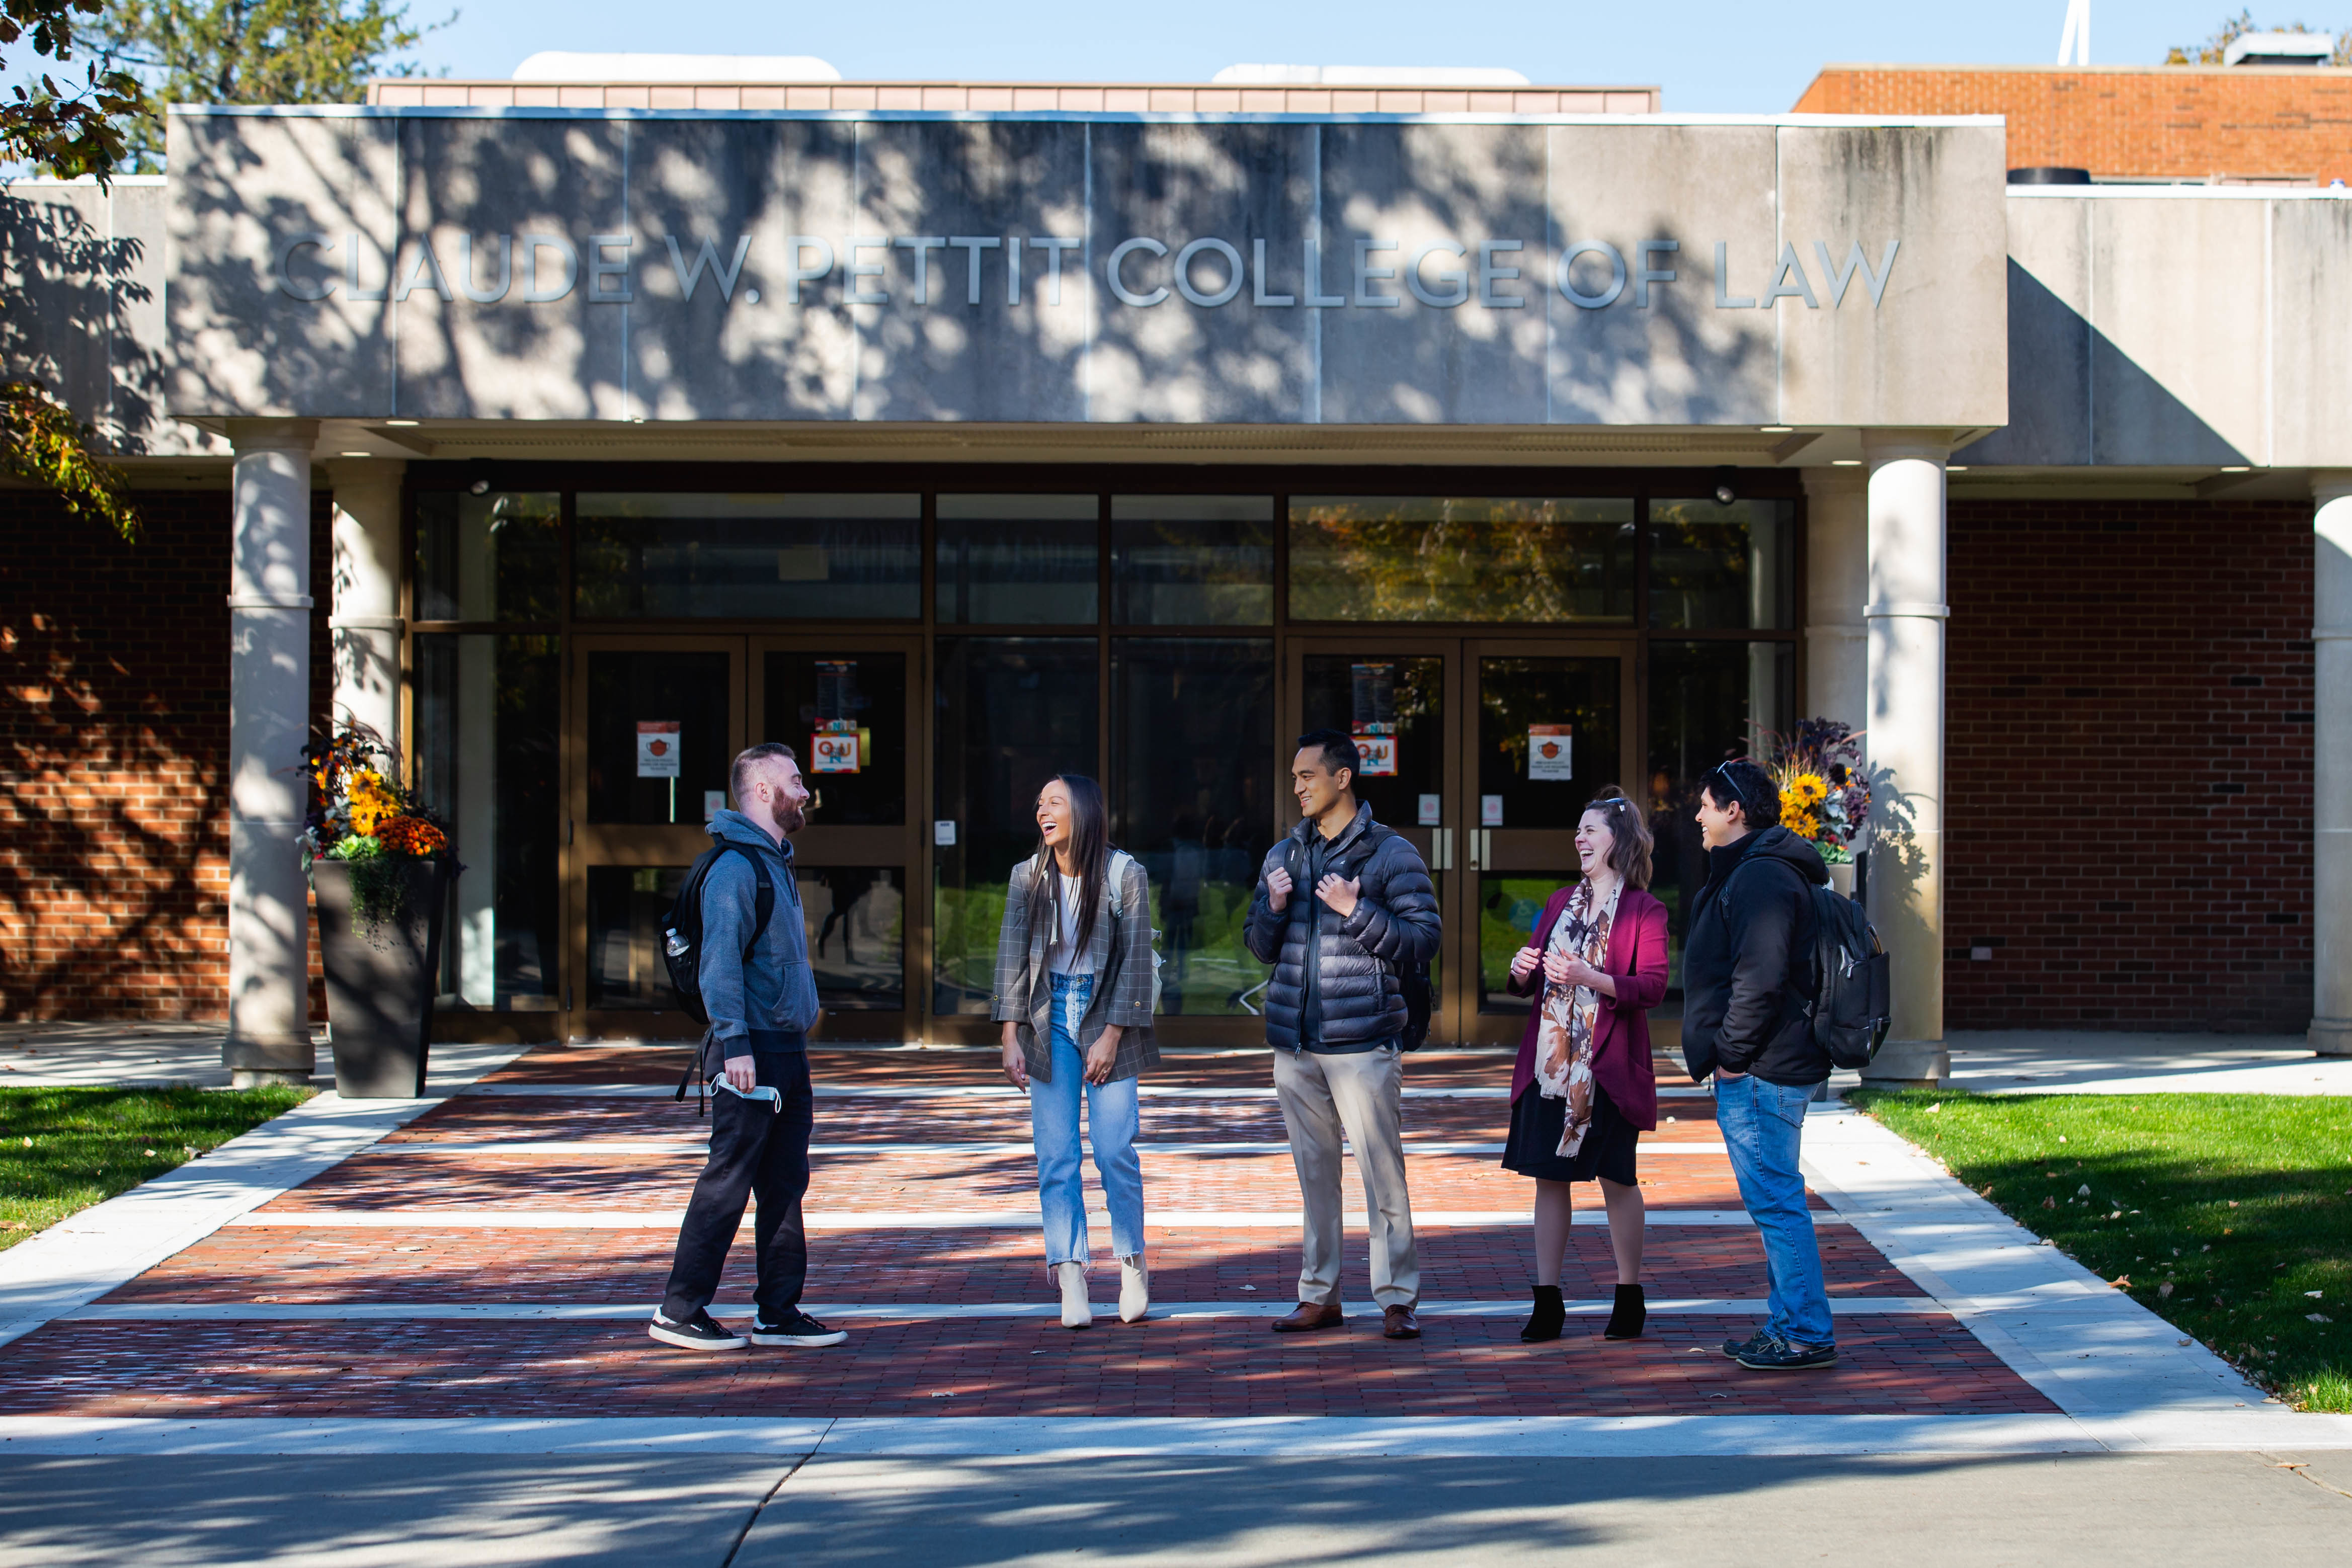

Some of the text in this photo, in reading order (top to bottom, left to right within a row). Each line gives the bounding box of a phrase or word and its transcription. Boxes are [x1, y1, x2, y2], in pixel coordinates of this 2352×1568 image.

[274, 232, 1900, 310] CLAUDE W. PETTIT COLLEGE OF LAW
